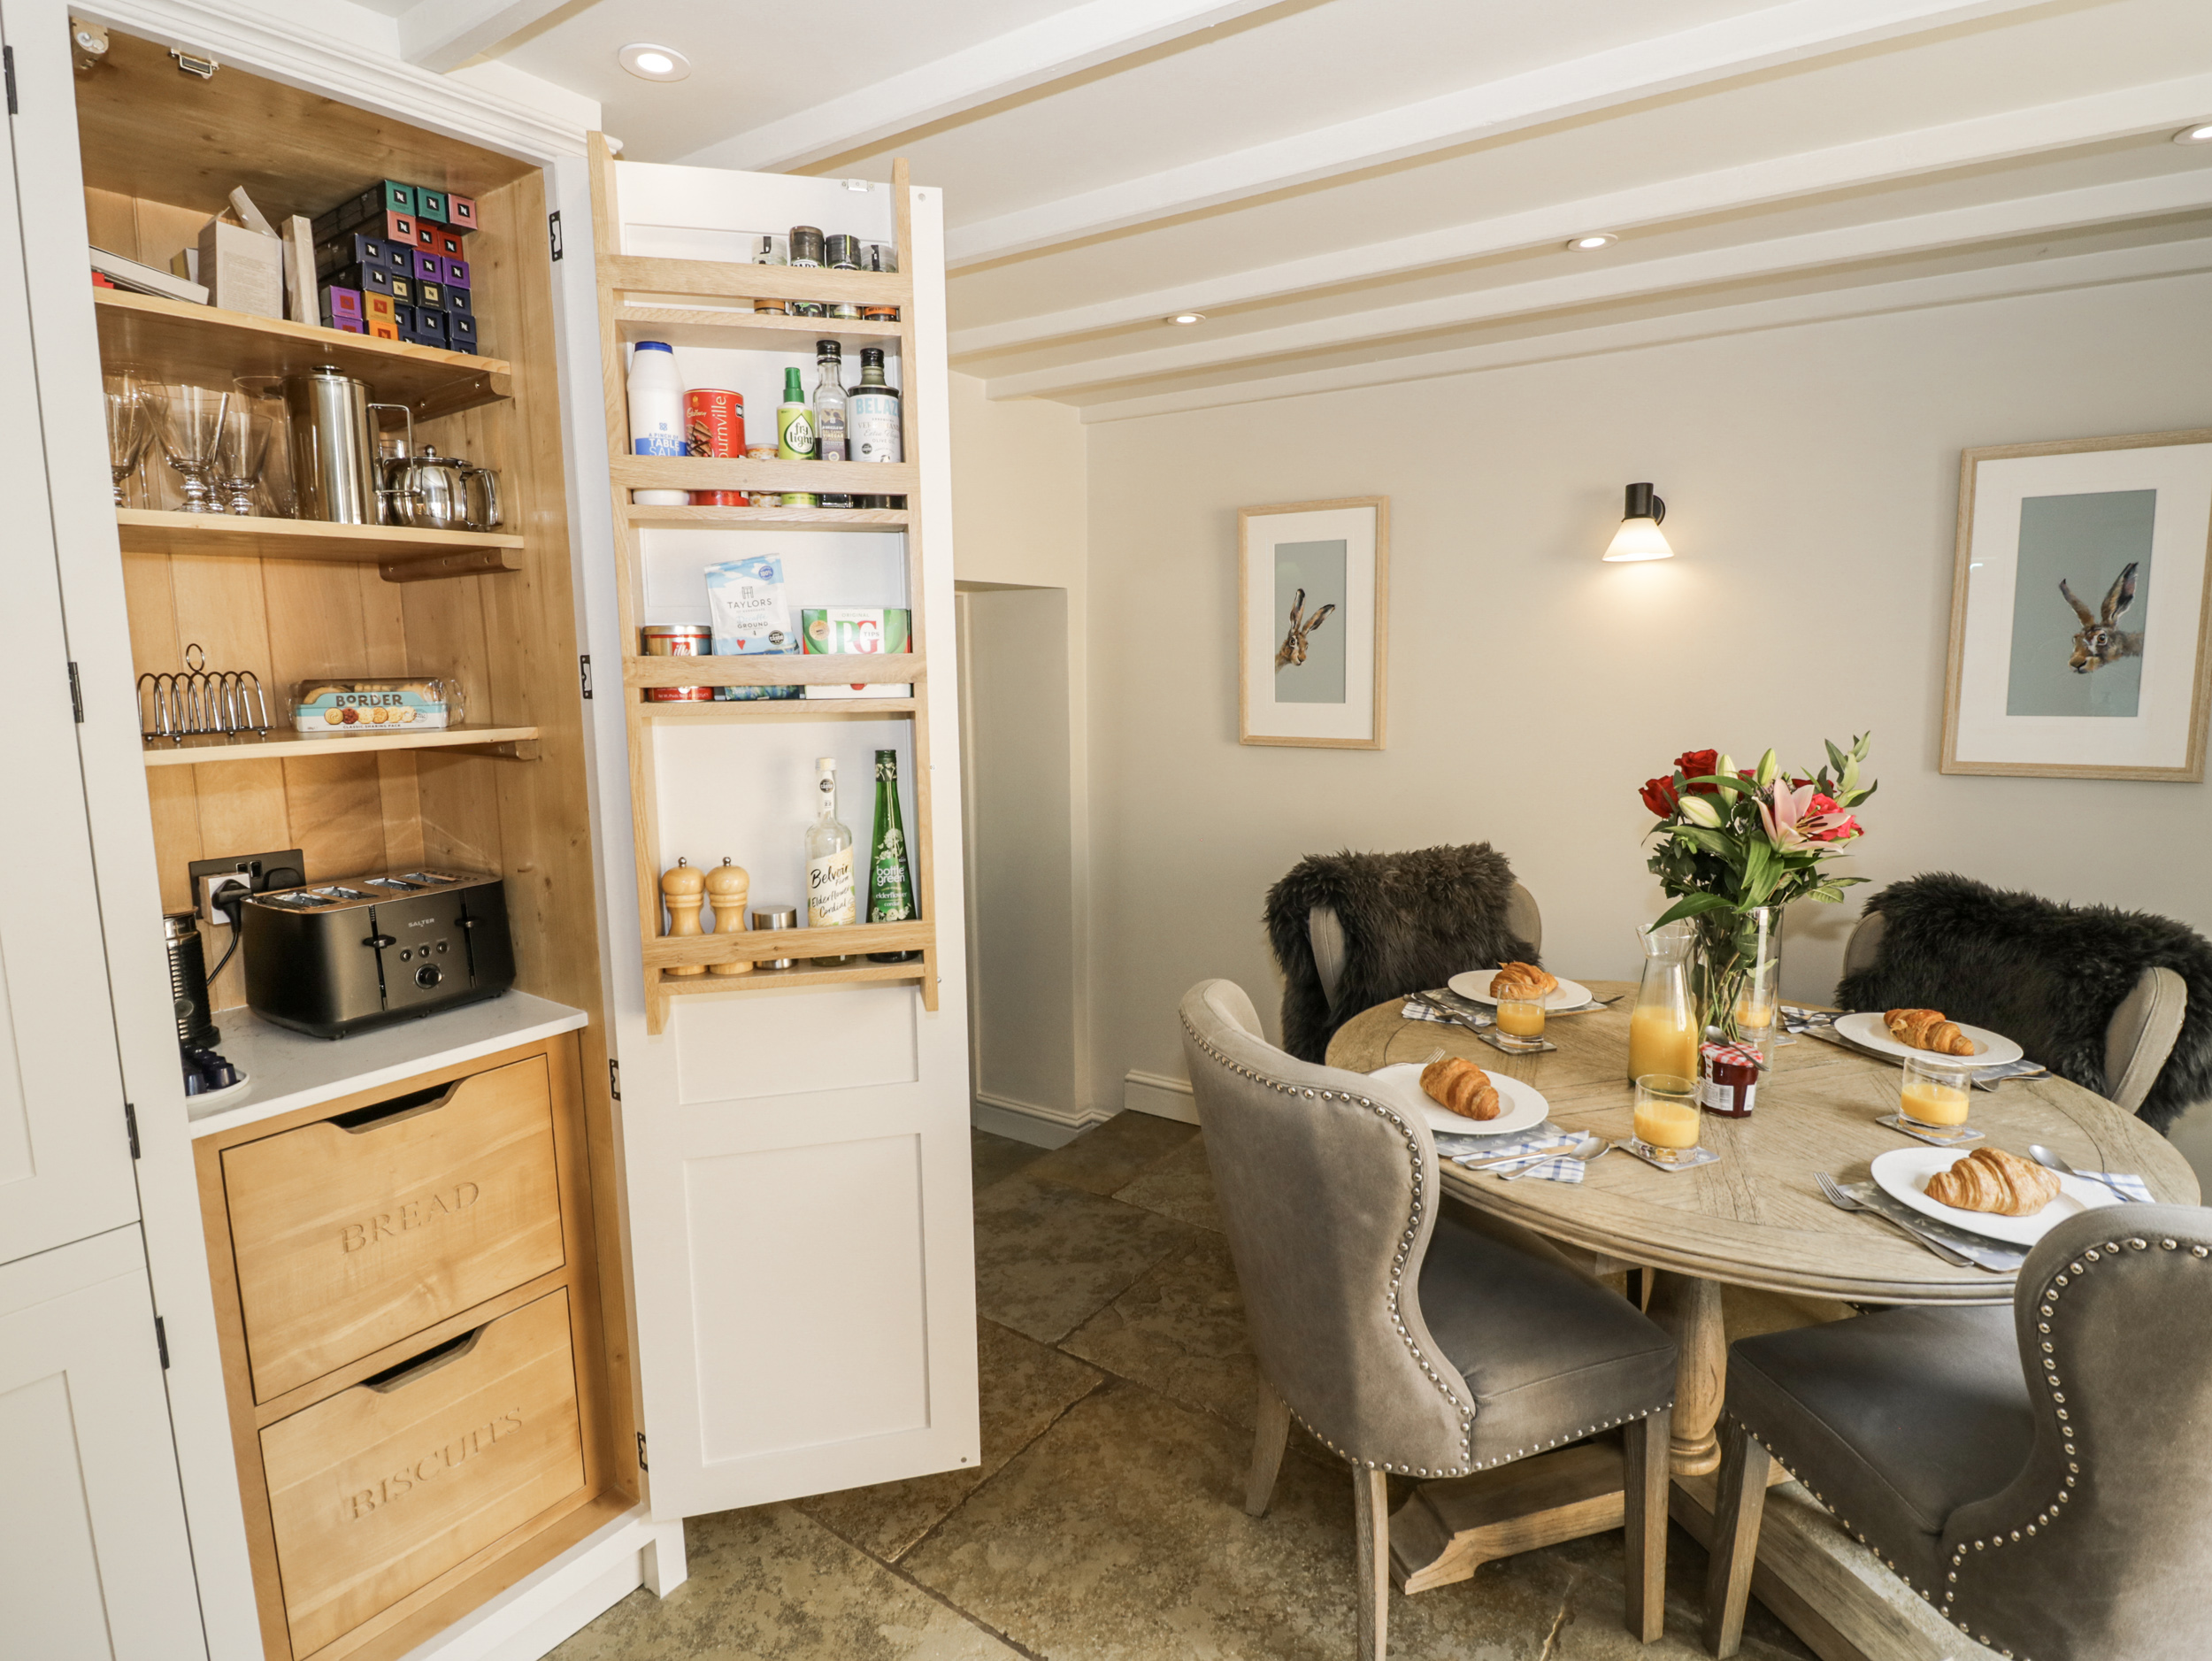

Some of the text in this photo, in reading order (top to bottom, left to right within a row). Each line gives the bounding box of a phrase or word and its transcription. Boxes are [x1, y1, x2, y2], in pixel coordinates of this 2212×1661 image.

[856, 397, 899, 418] BELAZ
[710, 396, 729, 458] ournville
[795, 422, 809, 436] fry
[649, 438, 680, 450] TABLE
[790, 432, 813, 448] light
[726, 598, 772, 609] TAYLORS
[833, 619, 880, 654] PG
[336, 694, 403, 707] BORDER
[810, 864, 849, 889] Belvoir
[876, 865, 905, 876] bottle
[877, 875, 906, 887] green
[811, 885, 850, 908] Elderflower
[819, 898, 847, 919] Cordial
[408, 918, 435, 927] SALTER
[340, 1181, 480, 1256] BREAD
[351, 1407, 522, 1519] BISCUITS
